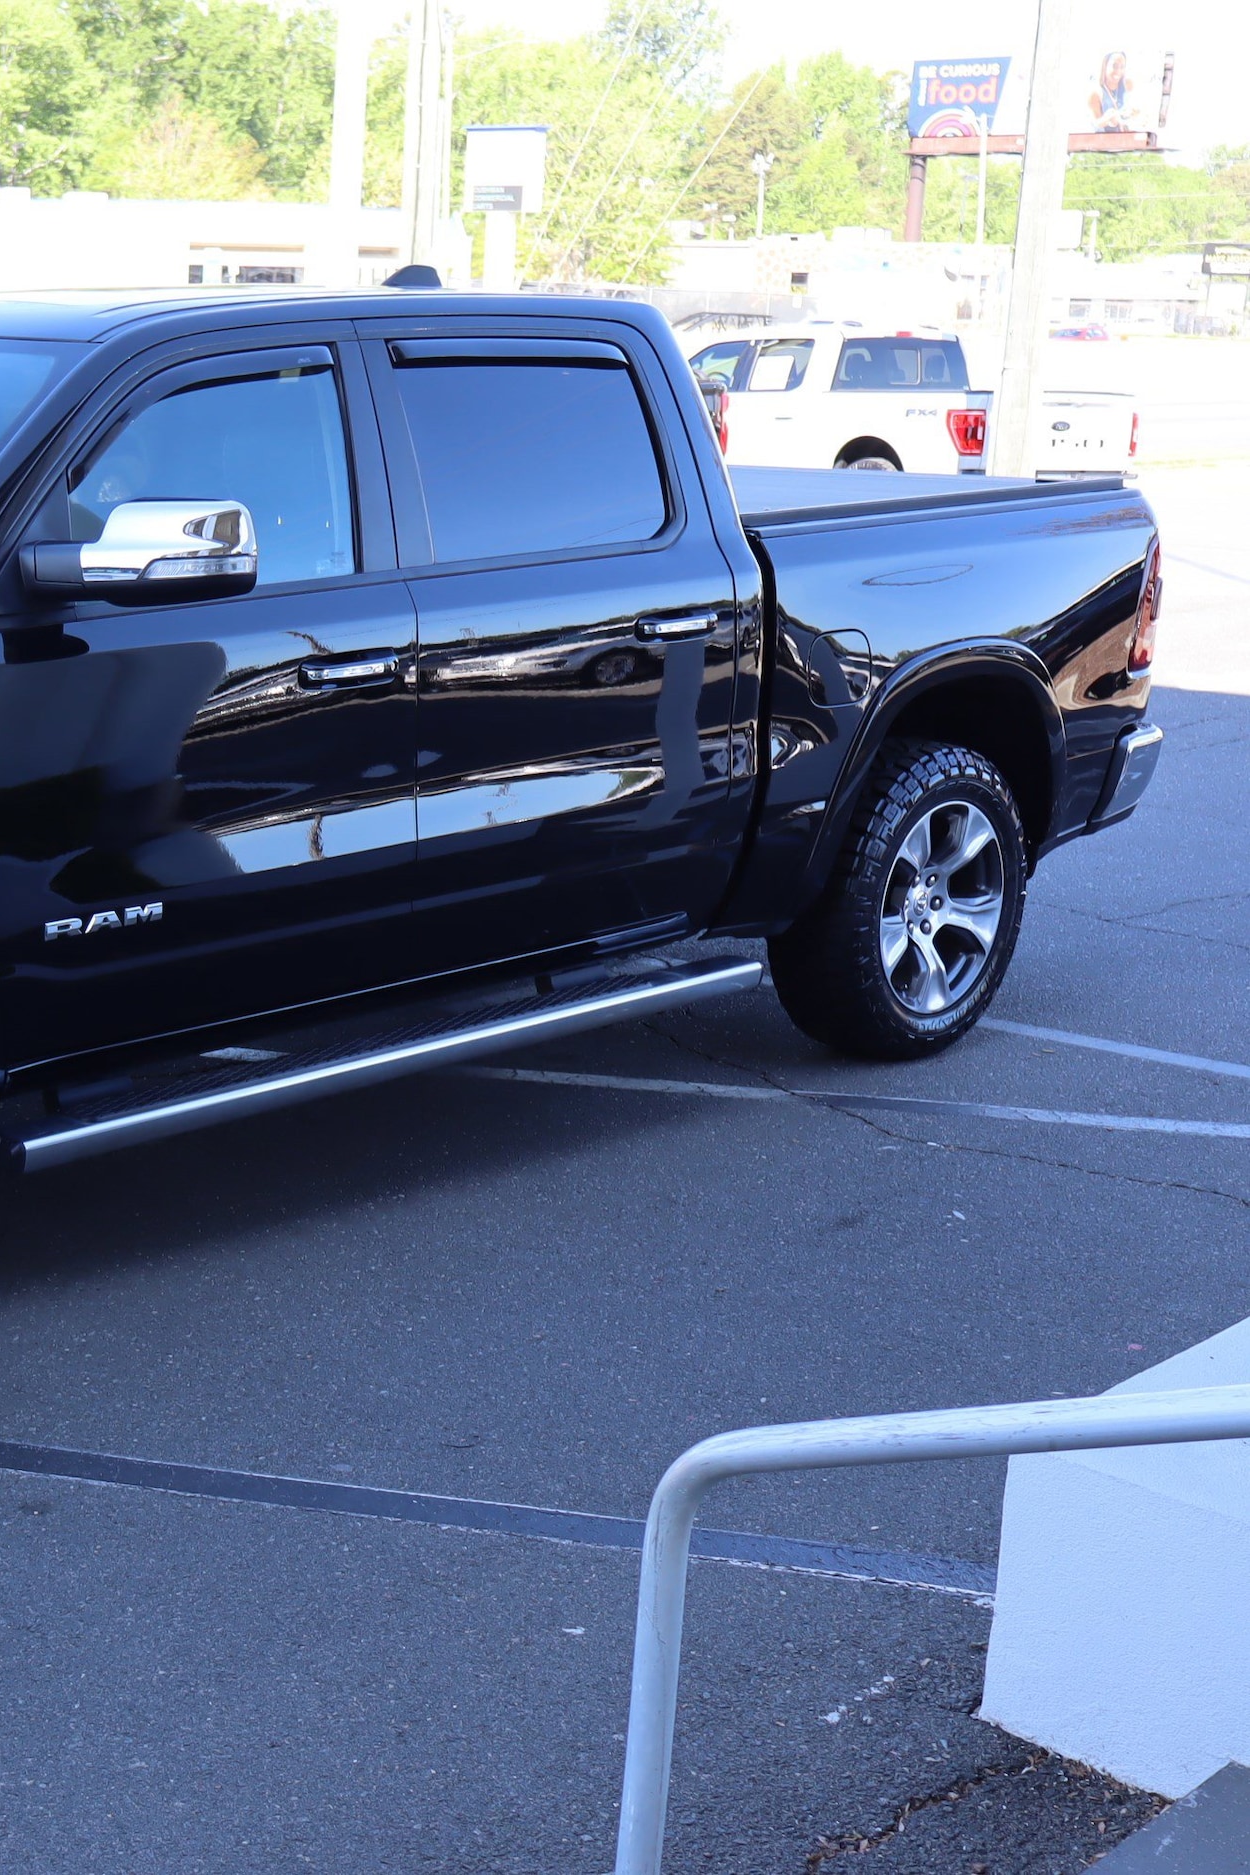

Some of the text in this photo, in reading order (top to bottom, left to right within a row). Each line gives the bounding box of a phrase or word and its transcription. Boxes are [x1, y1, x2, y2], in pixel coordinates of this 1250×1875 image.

[919, 63, 1001, 79] BE CURIOUS
[928, 78, 997, 104] food
[905, 408, 938, 417] FX4
[44, 902, 163, 941] RAM
